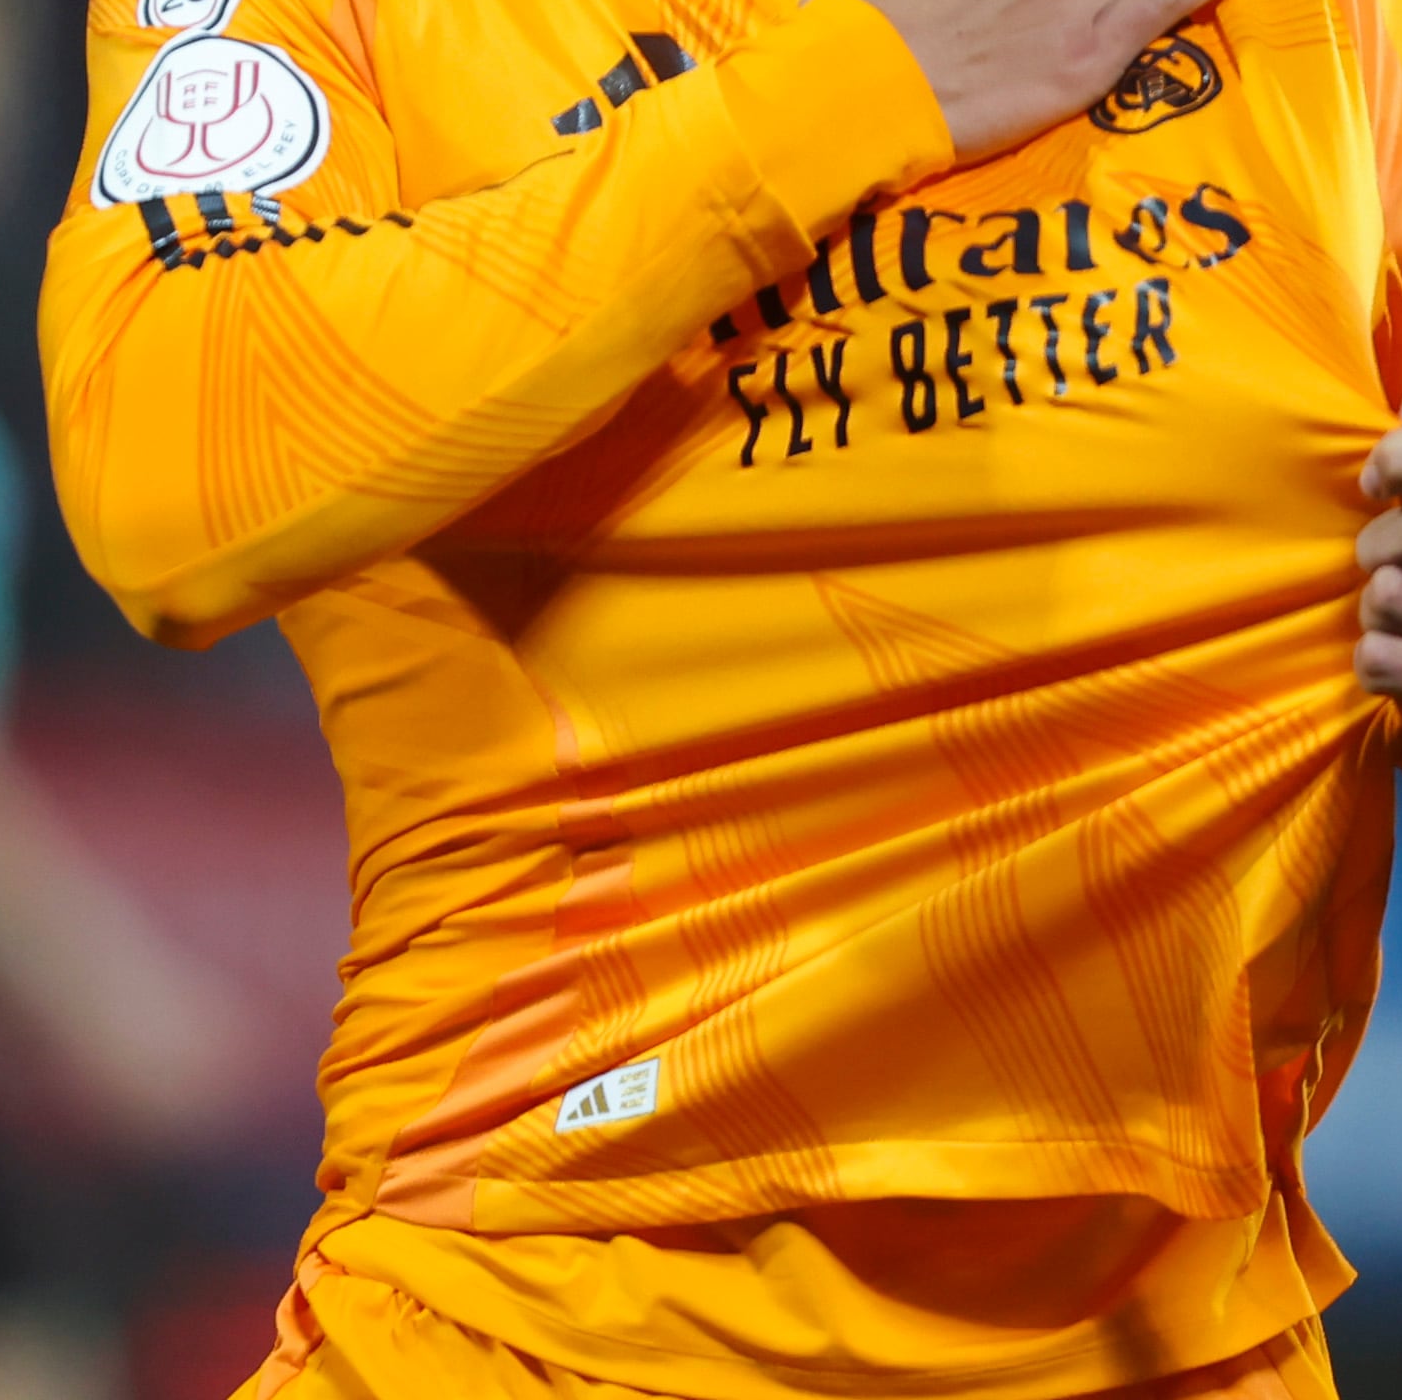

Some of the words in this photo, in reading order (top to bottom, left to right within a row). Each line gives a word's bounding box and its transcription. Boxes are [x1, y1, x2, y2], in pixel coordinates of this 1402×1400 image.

[273, 118, 298, 157] REY
[728, 338, 851, 467] FLY
[891, 277, 1176, 434] BETTER
